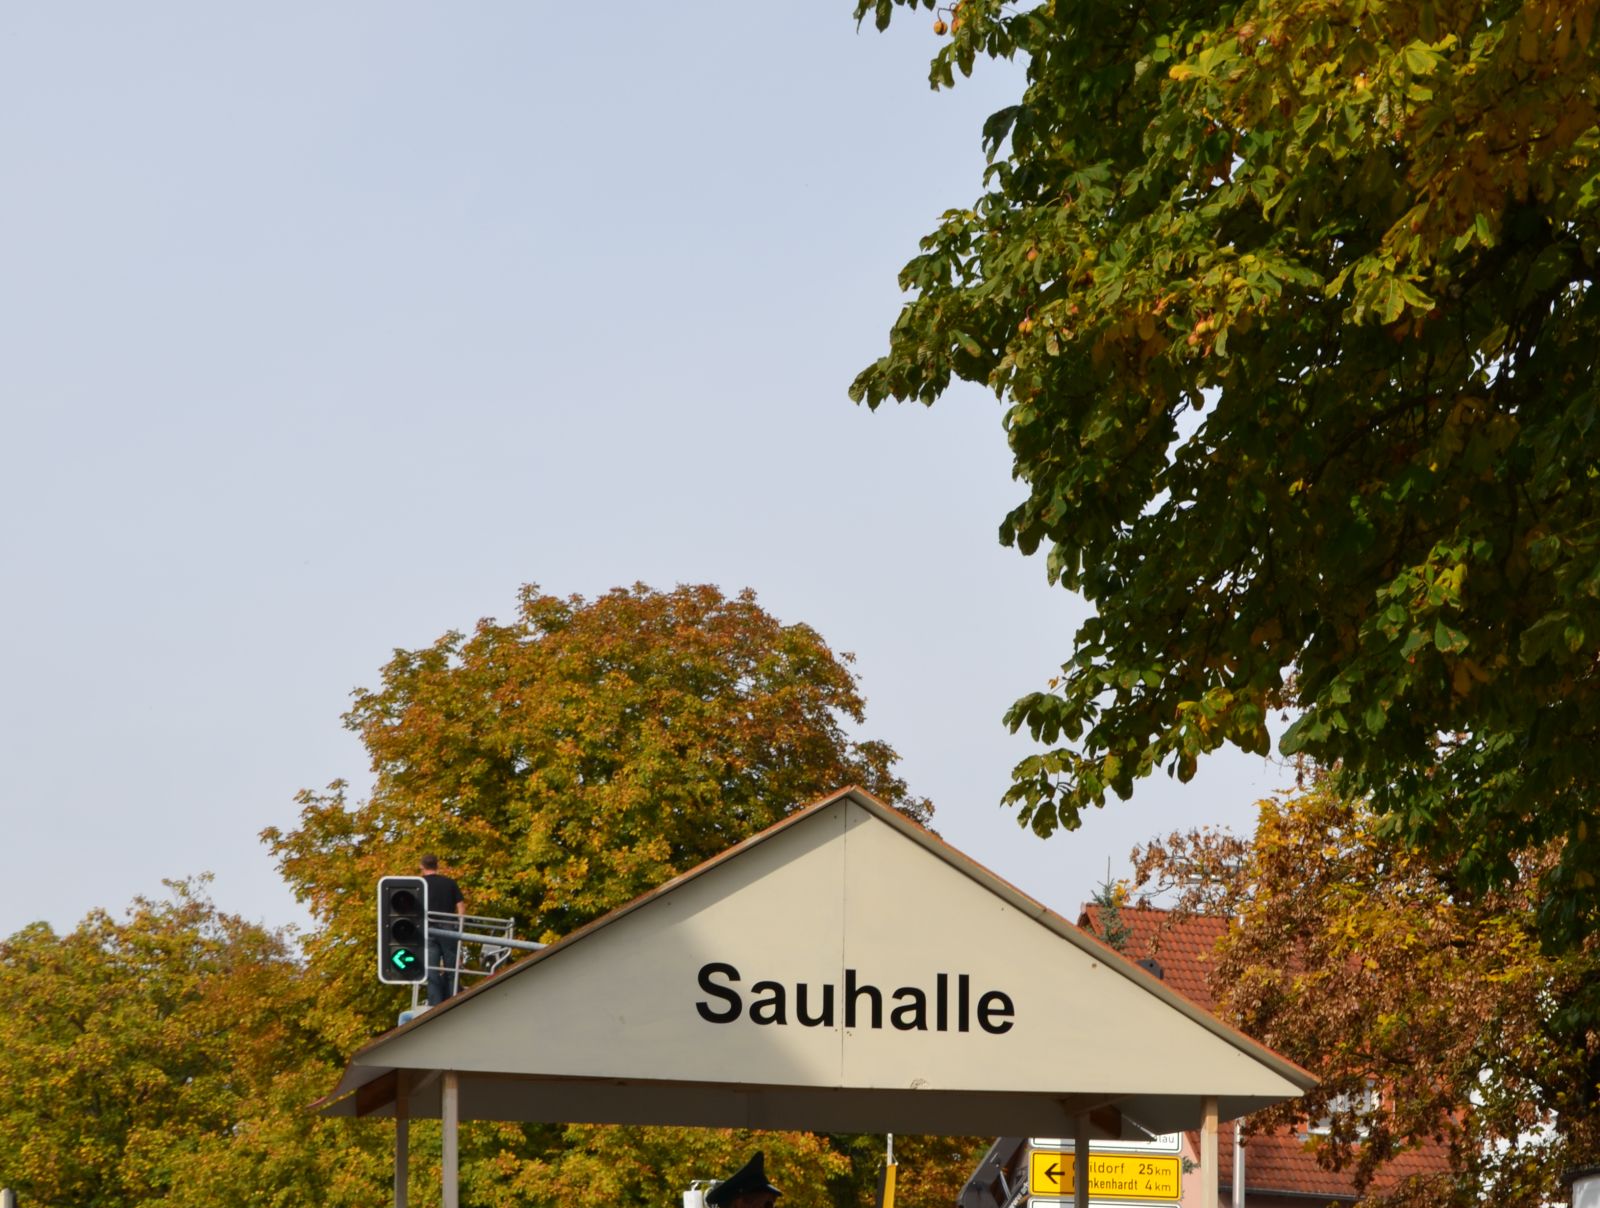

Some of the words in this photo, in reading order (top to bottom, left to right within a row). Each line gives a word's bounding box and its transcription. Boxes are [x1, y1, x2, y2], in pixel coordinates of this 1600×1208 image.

[695, 962, 1015, 1034] Sauhalle
[1072, 1162, 1124, 1174] ildorf
[1138, 1163, 1153, 1175] 25
[1155, 1165, 1171, 1176] km
[1072, 1177, 1138, 1191] nkenhardt
[1145, 1178, 1152, 1191] 4
[1155, 1181, 1171, 1192] km
